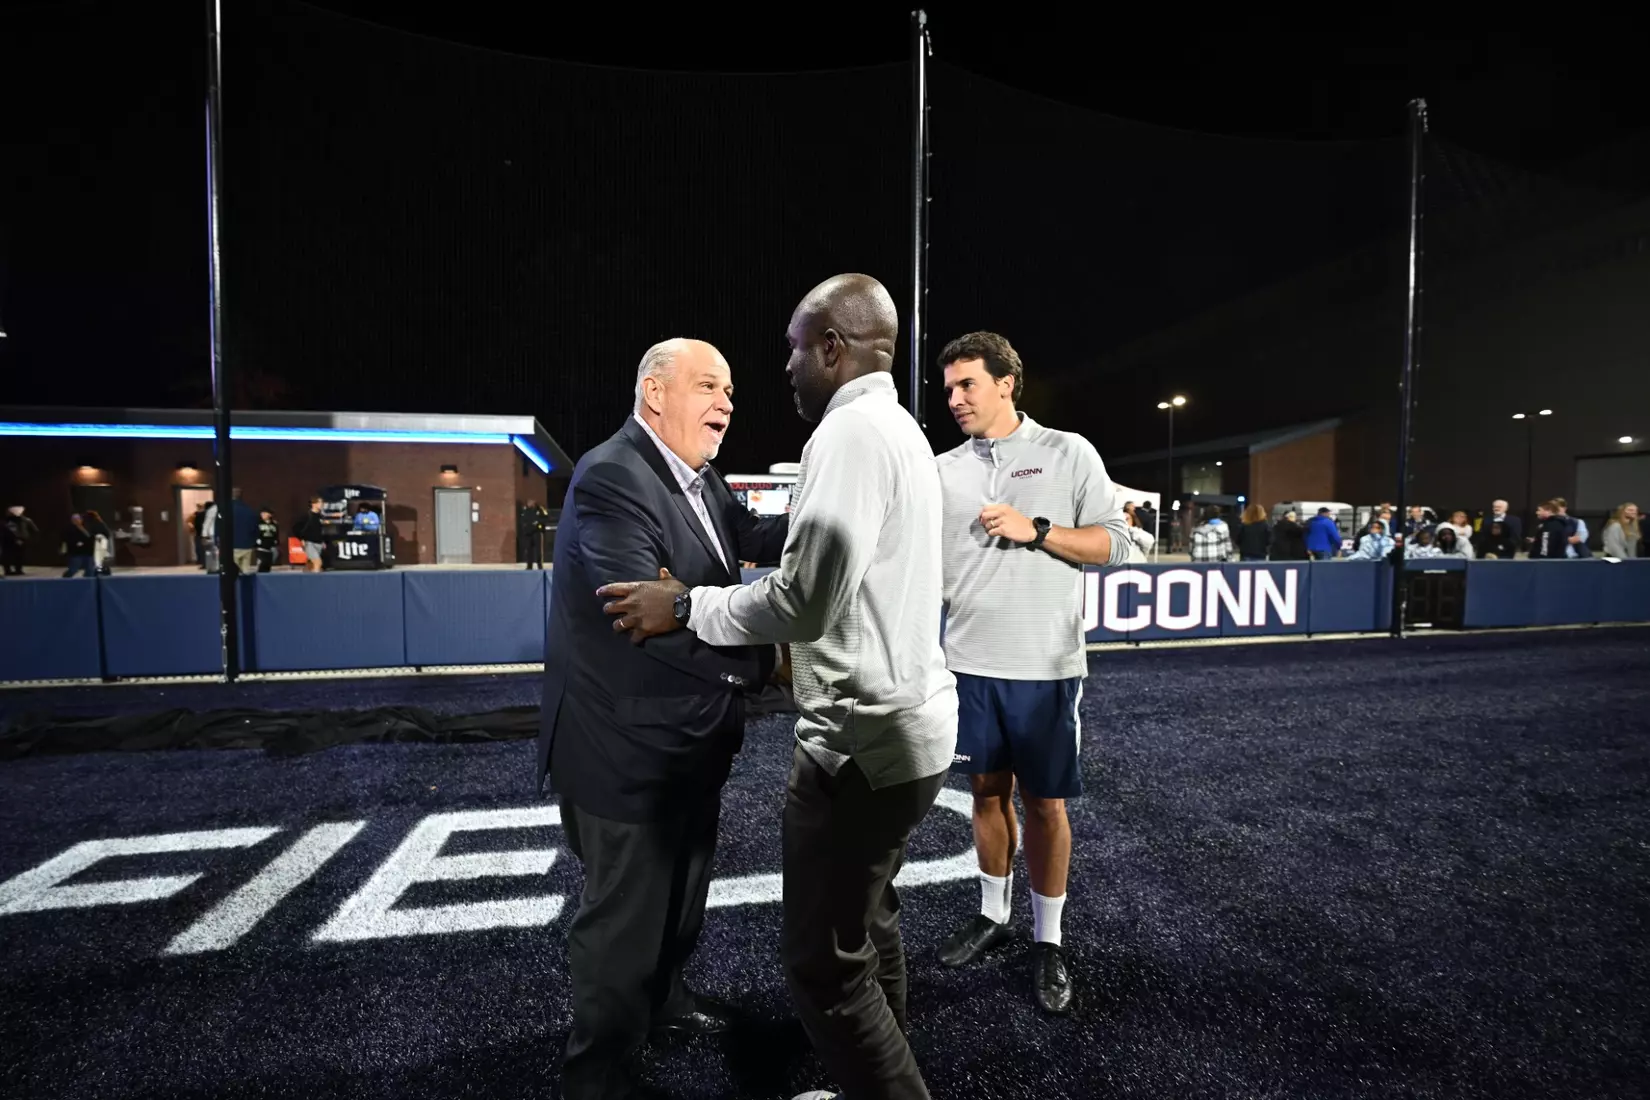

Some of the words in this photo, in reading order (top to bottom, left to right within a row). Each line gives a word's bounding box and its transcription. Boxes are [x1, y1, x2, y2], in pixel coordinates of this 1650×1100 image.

[1011, 467, 1042, 478] UCONN
[344, 488, 360, 498] Lite
[338, 541, 368, 559] Lite
[953, 753, 971, 761] ONN
